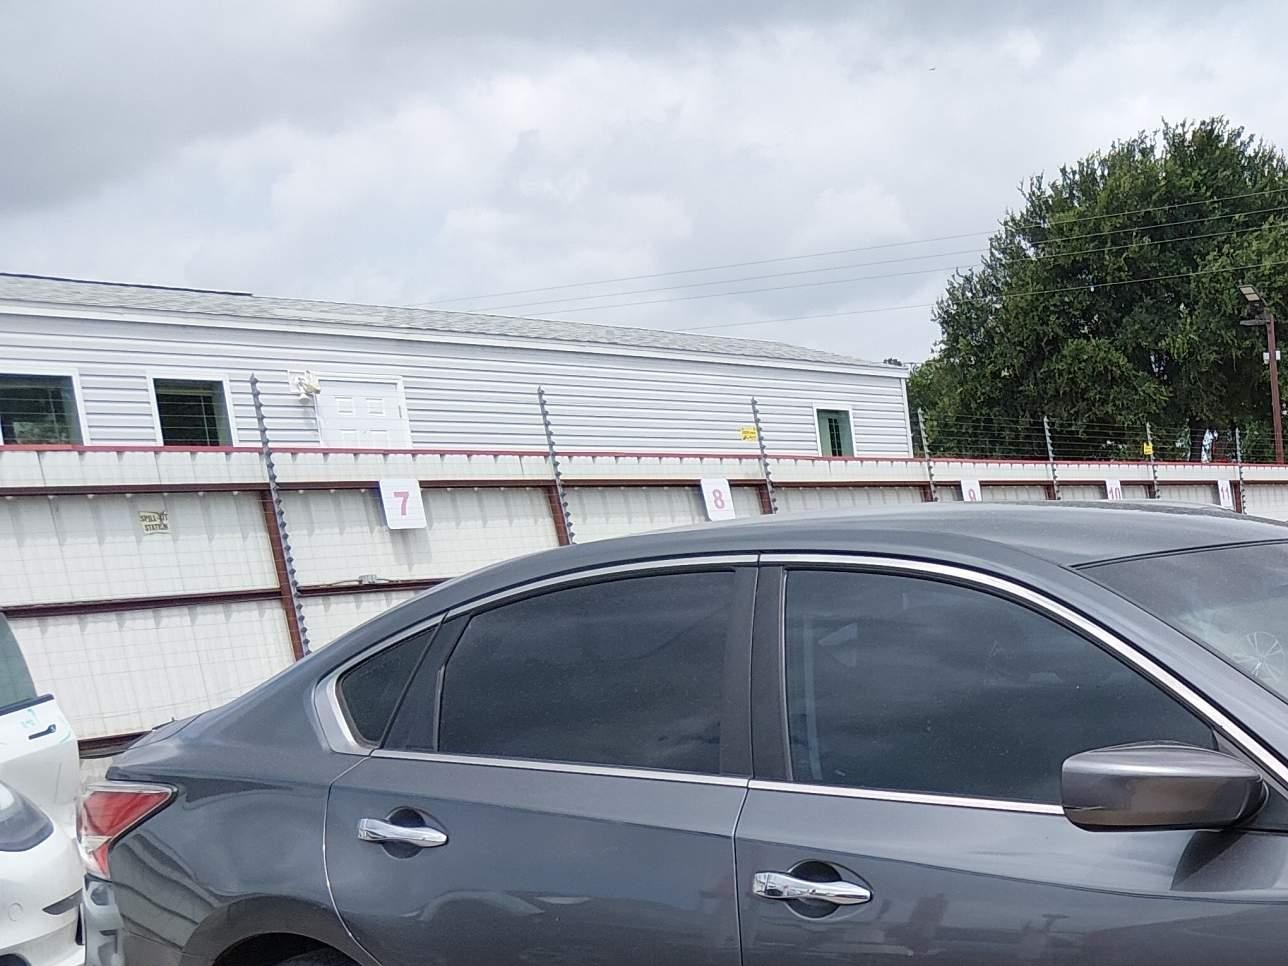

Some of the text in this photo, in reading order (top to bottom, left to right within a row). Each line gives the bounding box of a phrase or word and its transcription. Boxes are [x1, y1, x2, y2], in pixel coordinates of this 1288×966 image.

[712, 488, 726, 510] 8
[1109, 487, 1121, 501] 10
[1221, 487, 1231, 500] 11
[392, 491, 410, 516] 7
